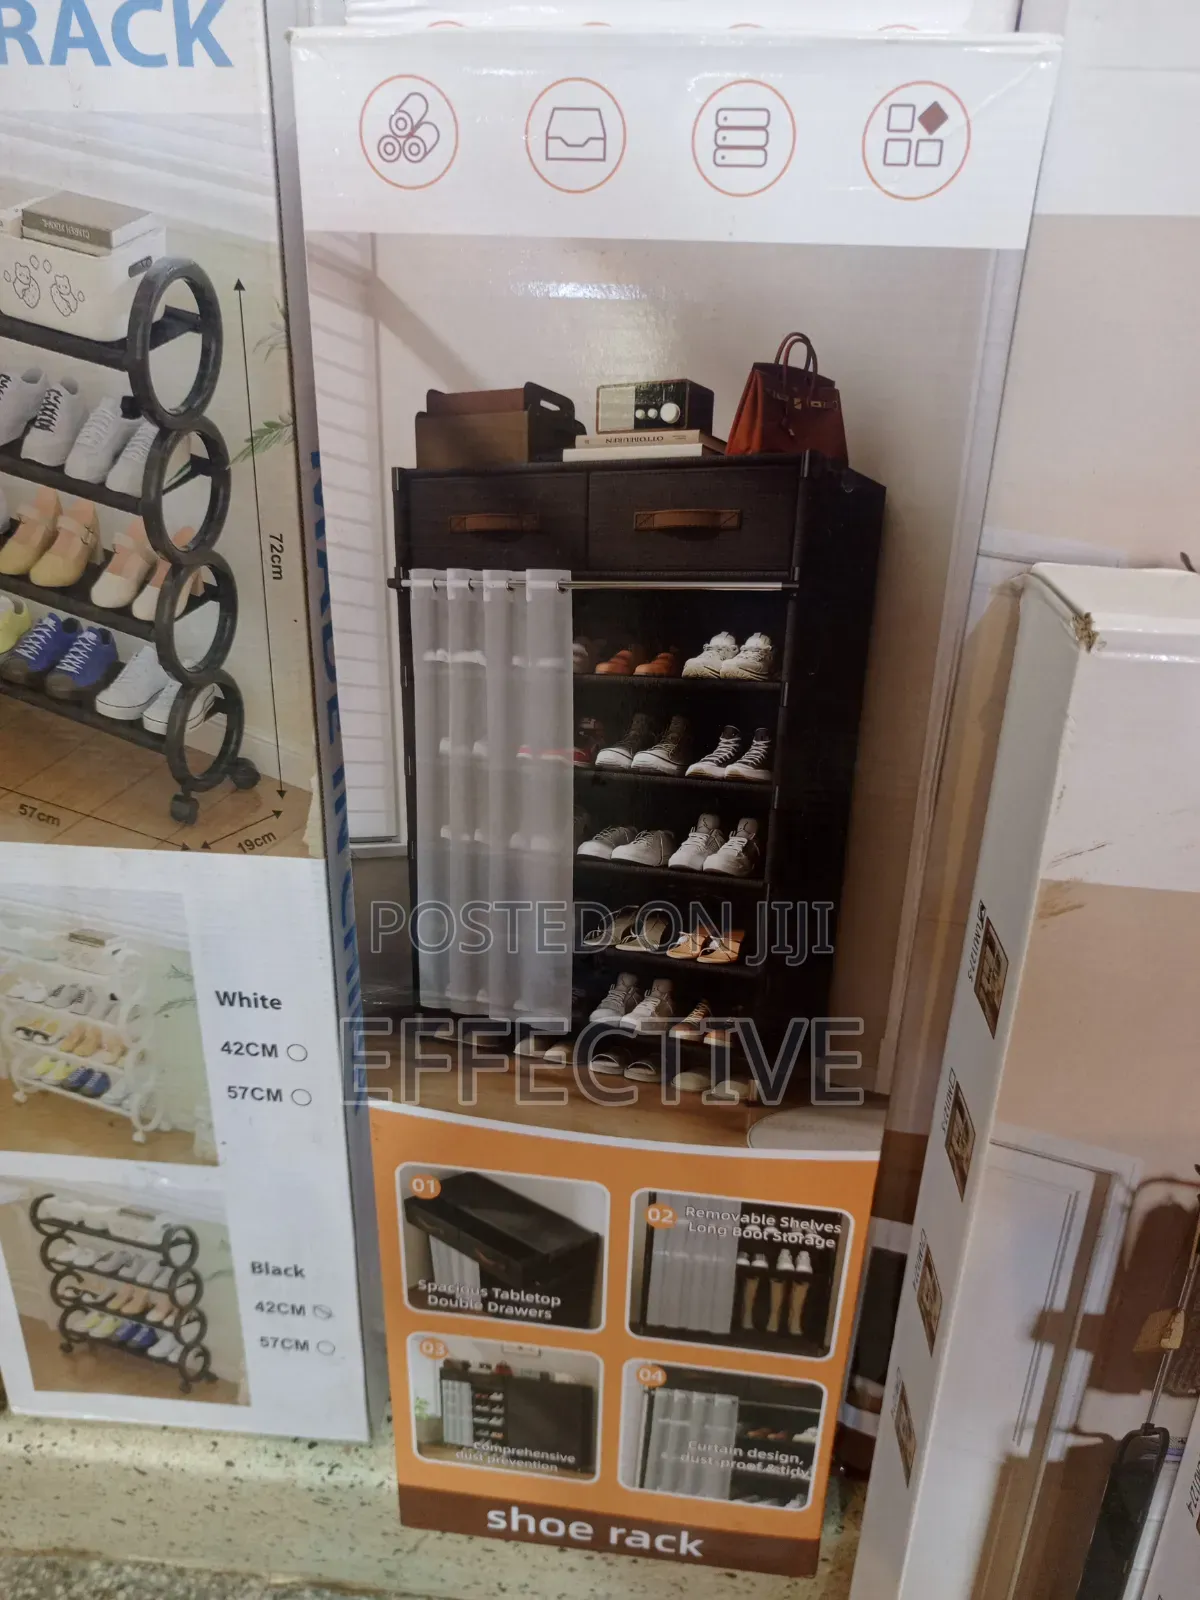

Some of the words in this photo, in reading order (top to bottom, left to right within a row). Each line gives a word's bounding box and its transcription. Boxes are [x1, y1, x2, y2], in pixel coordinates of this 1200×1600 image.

[0, 0, 234, 69] RACK
[268, 532, 284, 581] 72cm
[18, 803, 62, 828] 57cm
[237, 829, 277, 855] 19cm
[215, 989, 283, 1011] White
[220, 1041, 279, 1060] 42CM
[227, 1084, 284, 1103] 57CM
[412, 1178, 436, 1195] 01
[647, 1207, 674, 1224] 02
[685, 1206, 776, 1227] Removable
[779, 1216, 842, 1235] Shelves
[688, 1221, 728, 1237] Long
[732, 1226, 769, 1241] Boot
[772, 1231, 836, 1250] Storage
[250, 1261, 306, 1280] Black
[418, 1279, 488, 1298] Spacious
[492, 1287, 561, 1307] Tabletop
[255, 1300, 306, 1318] 42CM
[428, 1295, 483, 1312] Double
[488, 1301, 552, 1320] Drawers
[260, 1335, 310, 1353] 57CM
[421, 1340, 446, 1357] 03
[639, 1367, 664, 1384] 04
[688, 1441, 744, 1457] Curtain
[455, 1450, 484, 1462] dust
[488, 1456, 559, 1473] prevention
[486, 1505, 594, 1542] shoe
[609, 1525, 704, 1557] rack
